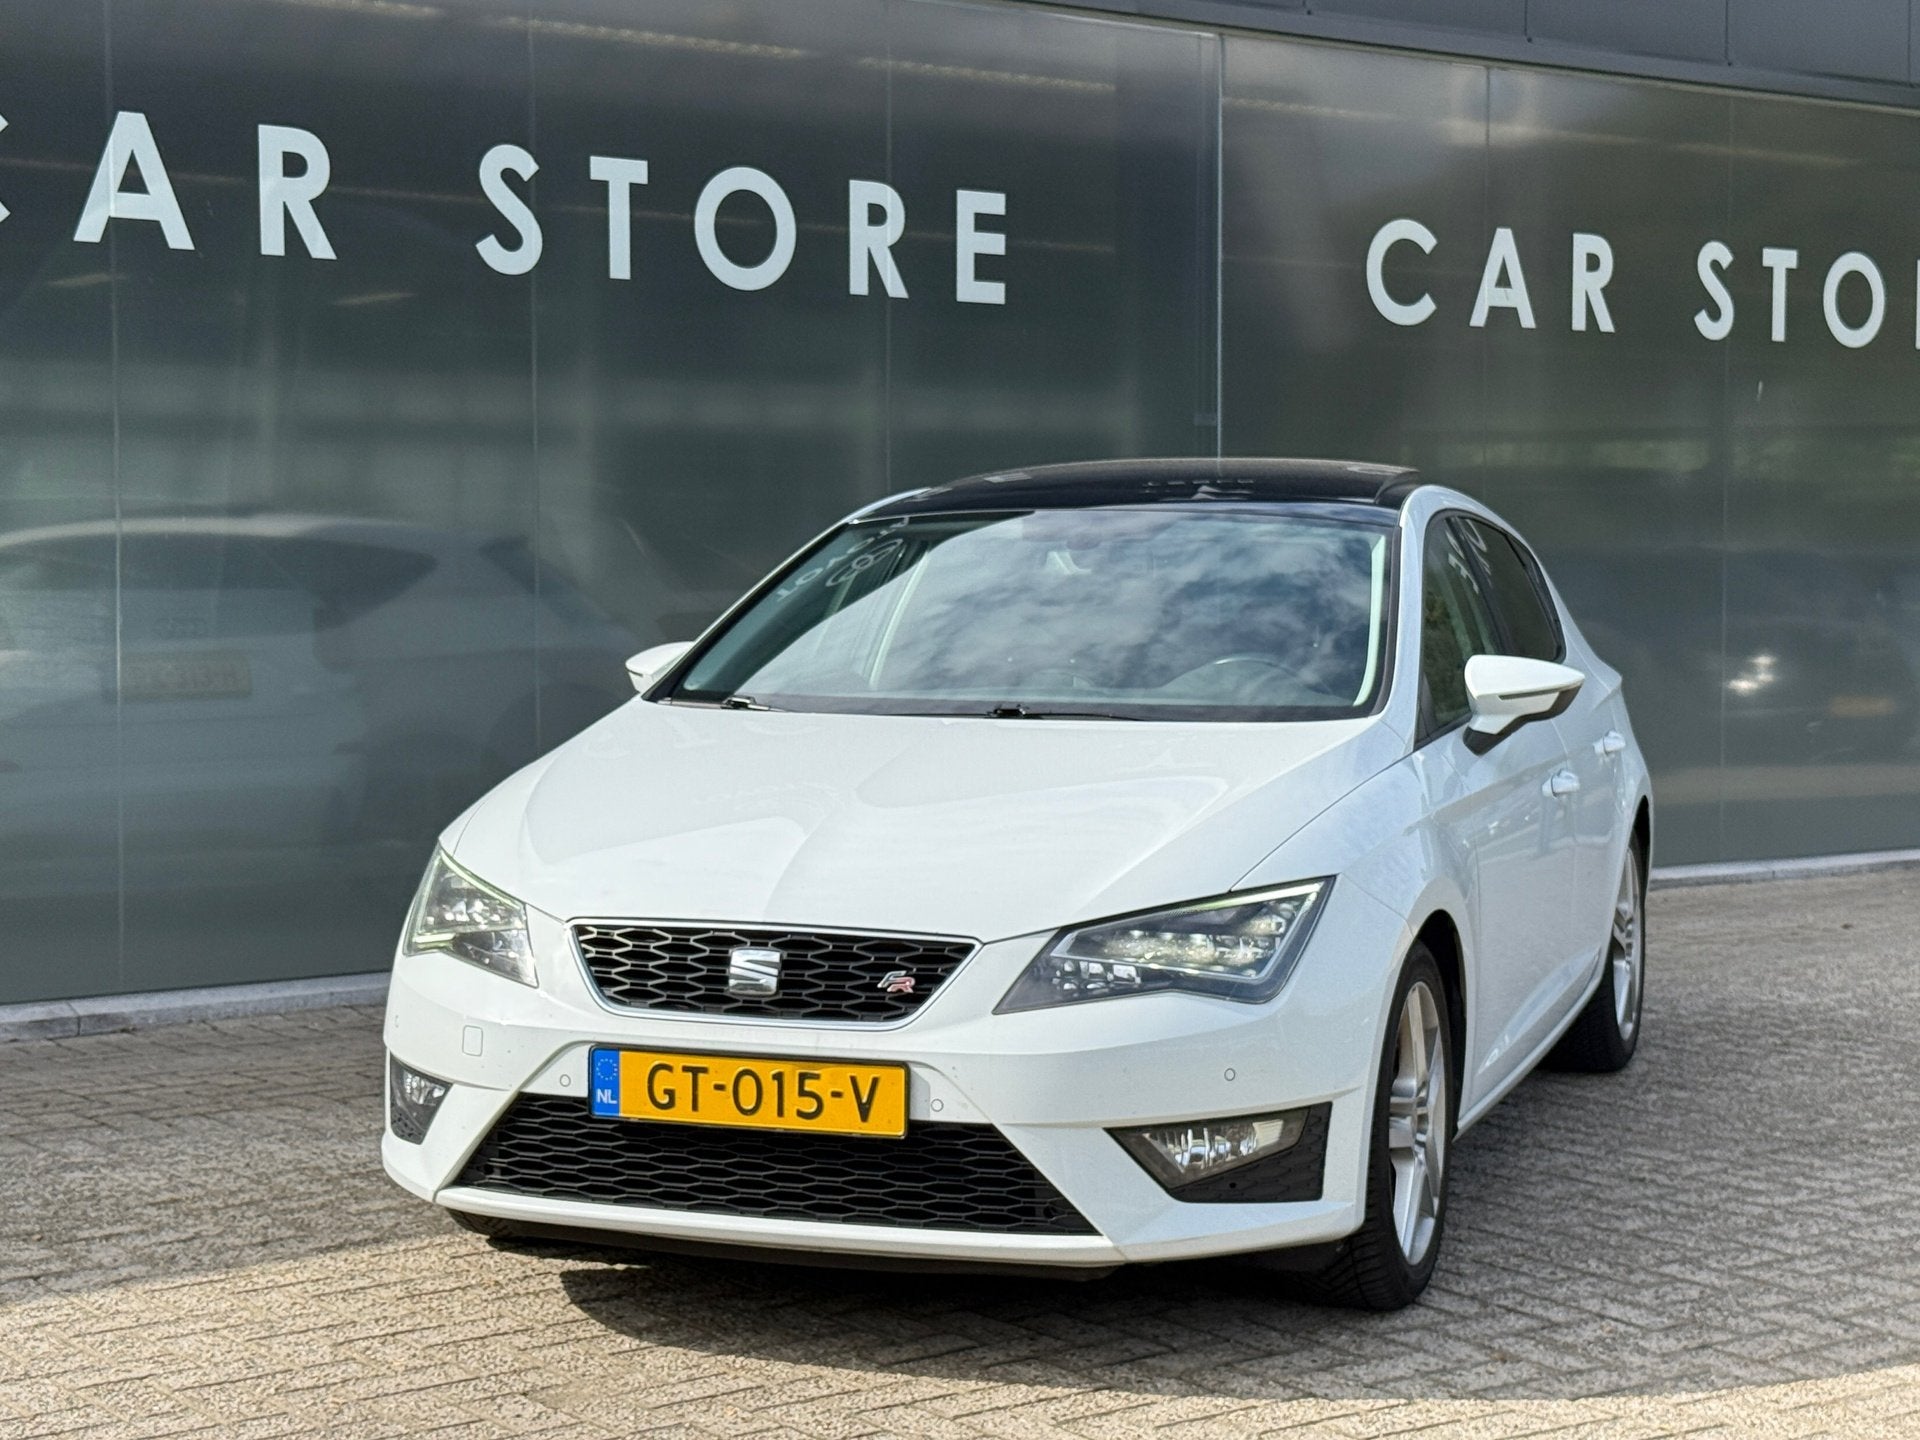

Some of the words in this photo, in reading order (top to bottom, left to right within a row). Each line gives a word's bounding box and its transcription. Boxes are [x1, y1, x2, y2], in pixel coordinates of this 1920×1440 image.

[0, 111, 338, 261] AR
[475, 143, 1007, 306] STORE
[1366, 218, 1616, 333] CAR
[1694, 240, 1920, 351] STO
[596, 1088, 618, 1105] NL
[646, 1061, 881, 1124] GT-015-V
